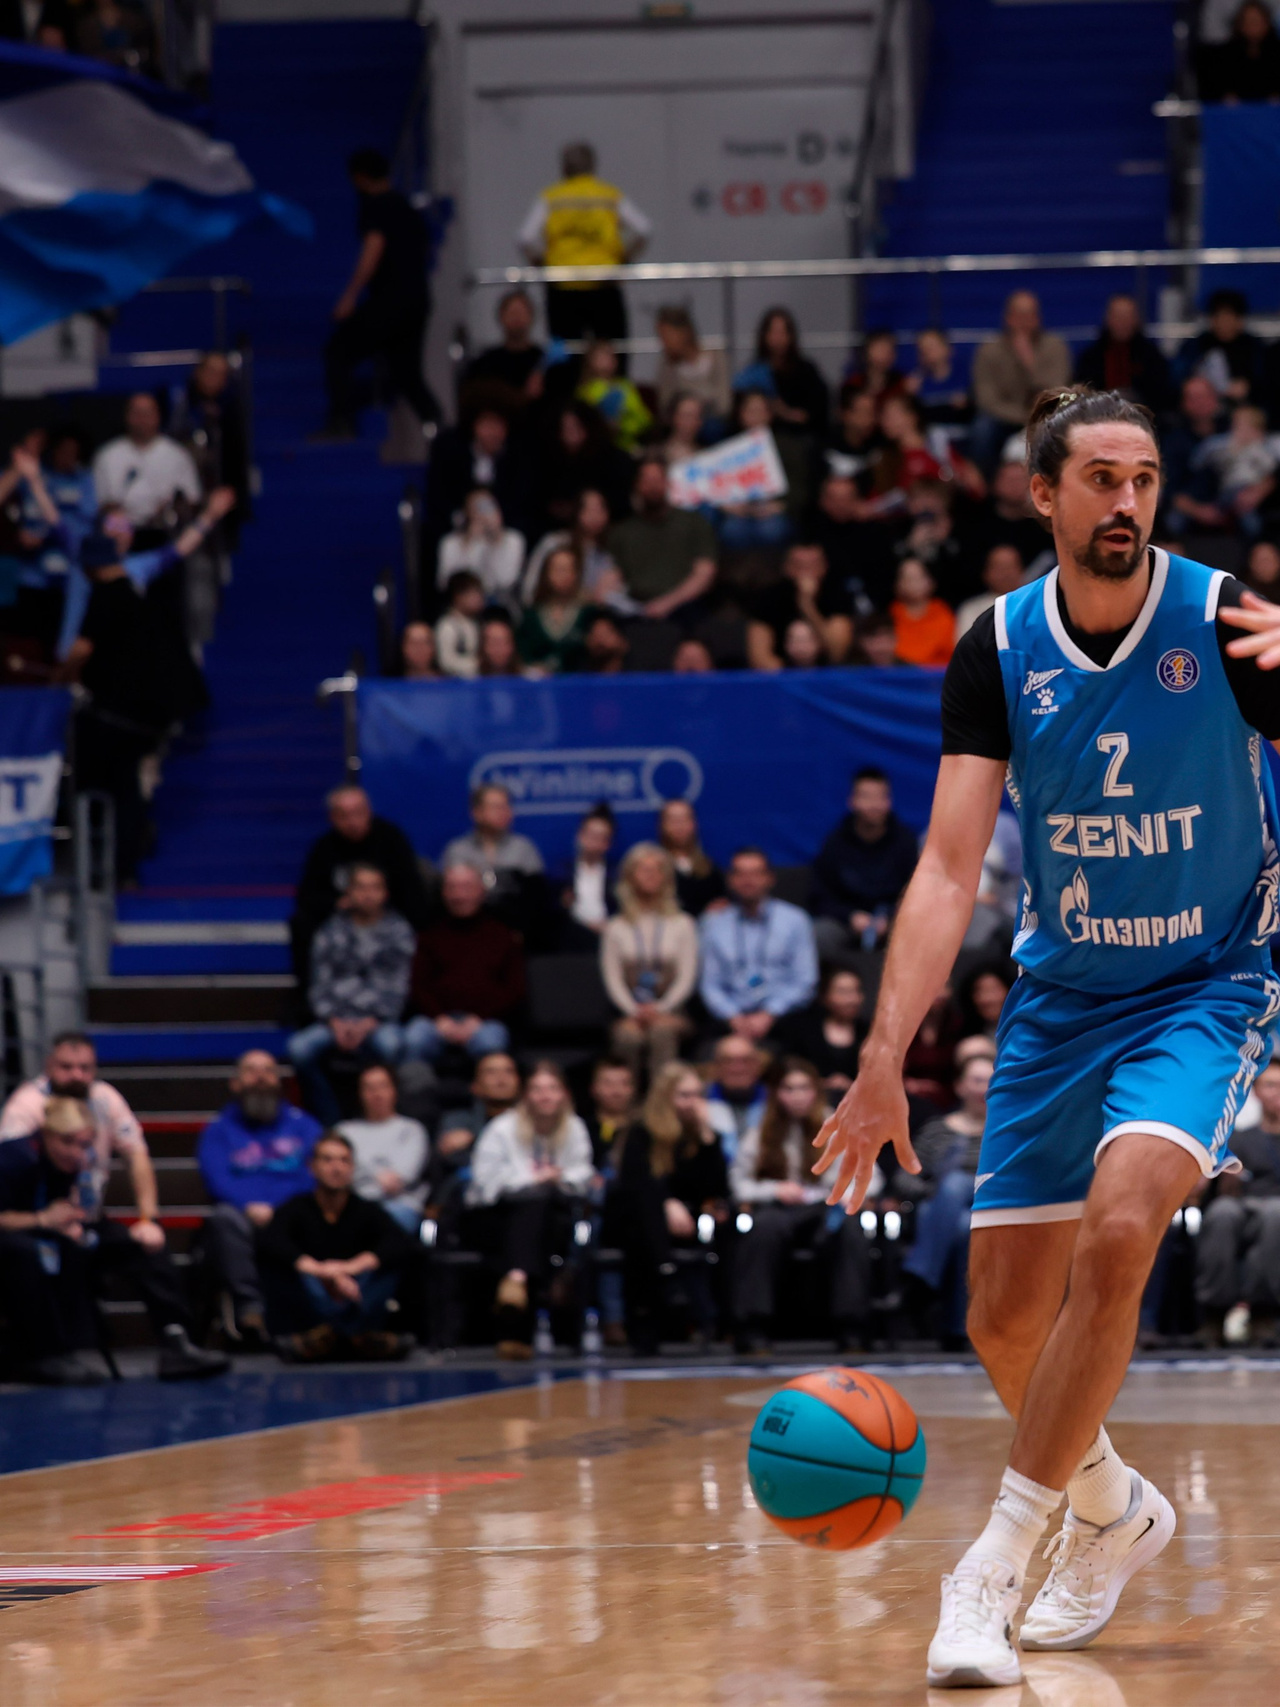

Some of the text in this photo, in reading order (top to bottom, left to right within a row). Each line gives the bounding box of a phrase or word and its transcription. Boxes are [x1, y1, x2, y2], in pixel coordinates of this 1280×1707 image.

[1031, 705, 1060, 715] KELME
[1097, 732, 1134, 797] 2
[1047, 804, 1203, 858] ZENIT
[1090, 906, 1203, 947] ГАЗПРОМ
